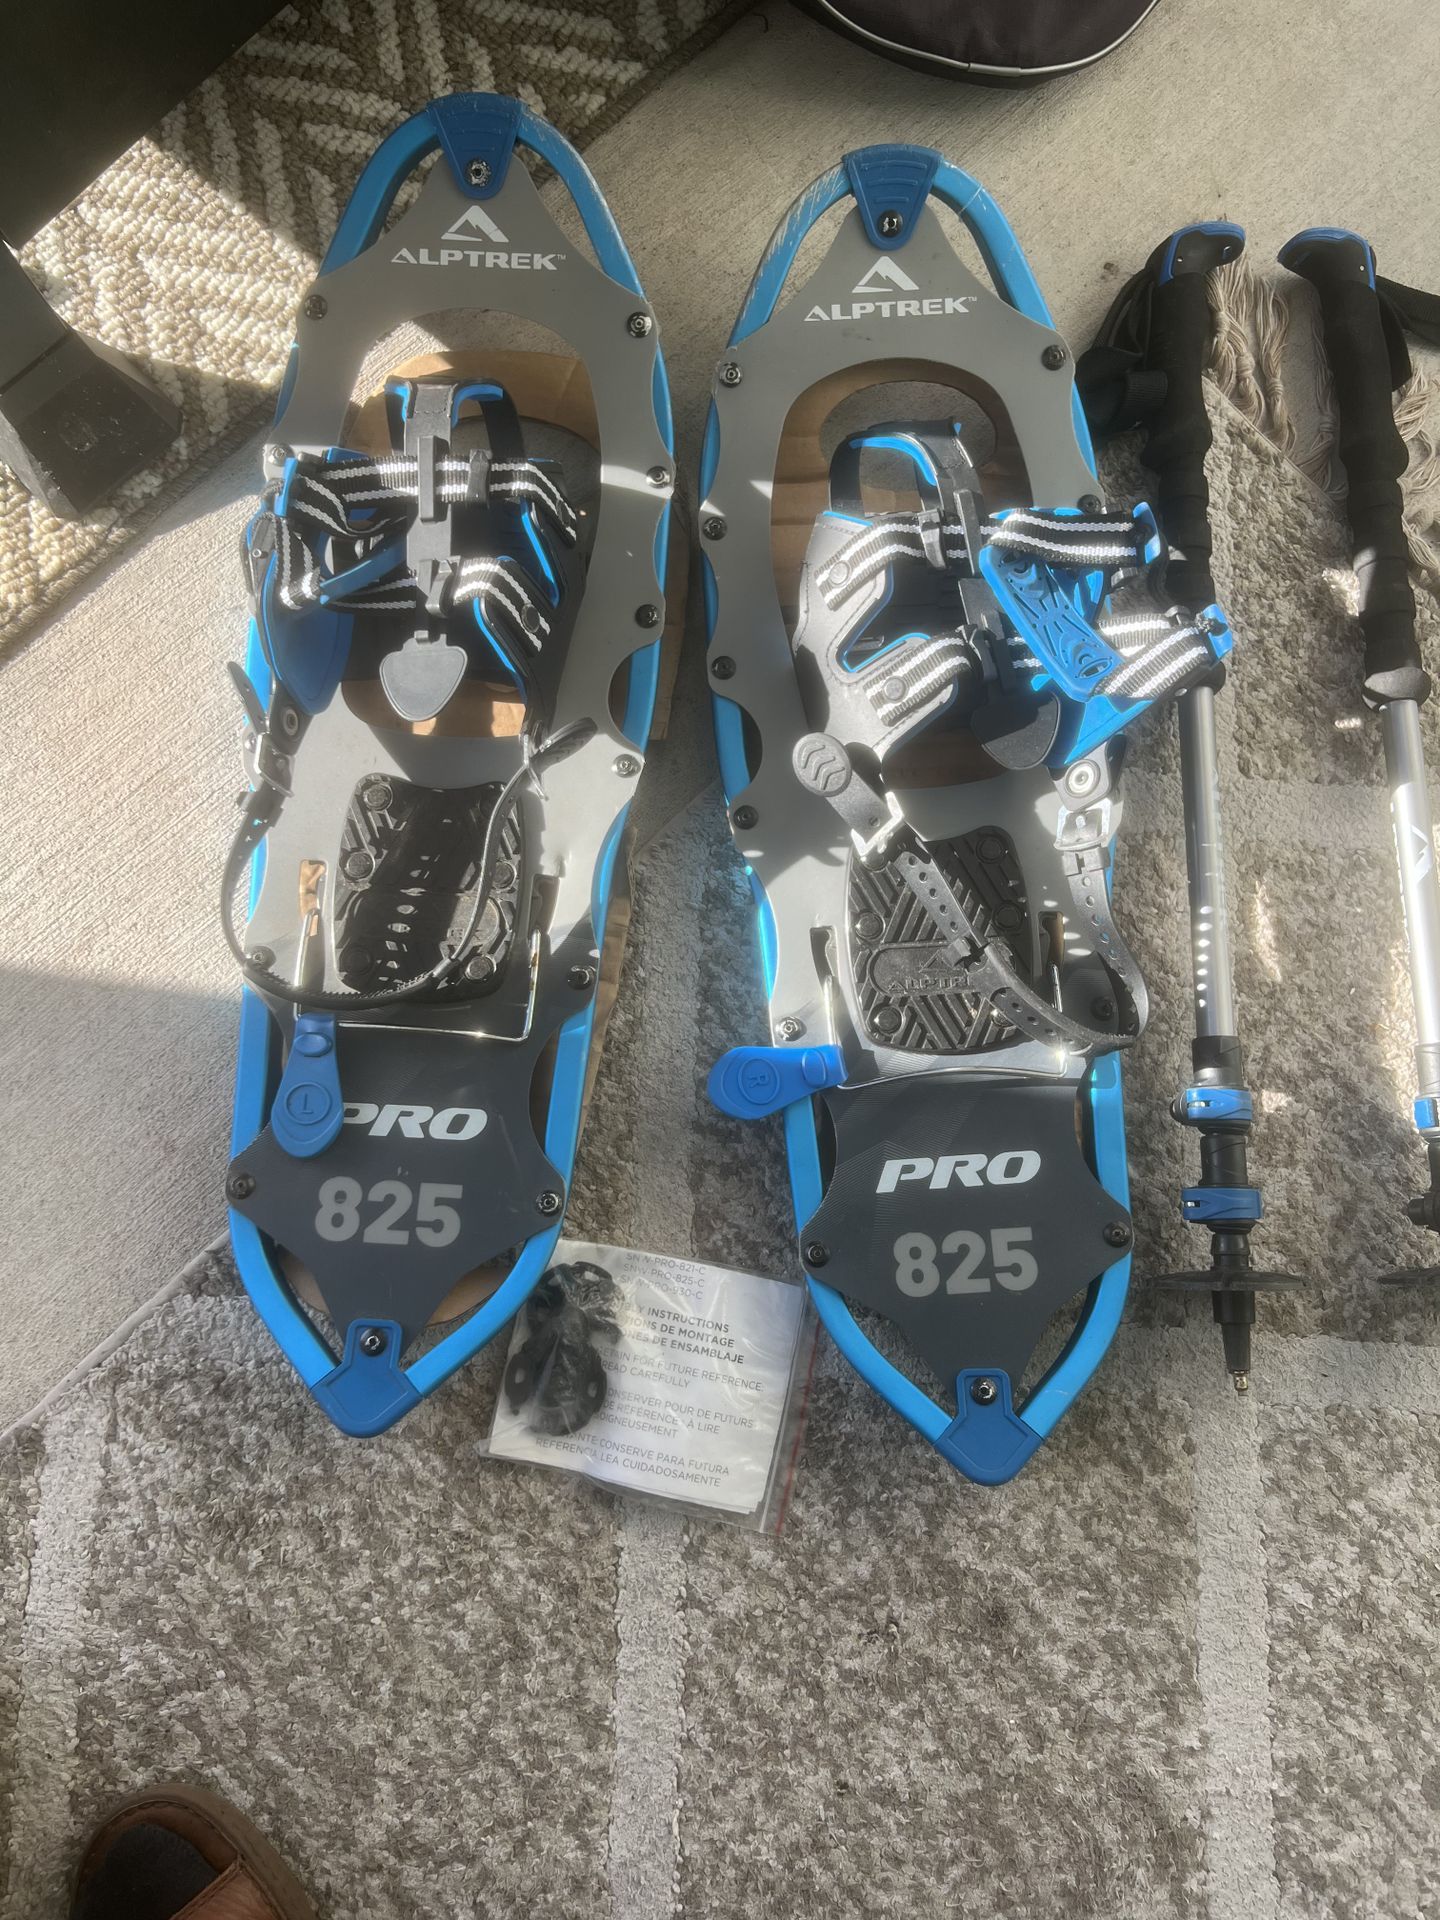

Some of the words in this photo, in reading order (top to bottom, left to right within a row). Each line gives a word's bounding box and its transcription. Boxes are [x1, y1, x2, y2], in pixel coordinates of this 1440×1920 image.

[300, 1092, 314, 1115] L
[875, 1150, 1042, 1194] PRO
[314, 1176, 464, 1248] 825
[893, 1226, 1039, 1298] 825
[647, 1306, 730, 1334] INSTRUCTIONS
[652, 1335, 668, 1347] DE
[671, 1340, 745, 1364] ENSAMBLAJE
[660, 1323, 676, 1335] DE
[678, 1329, 735, 1348] MONTAGE
[600, 1347, 631, 1361] ETAIN
[632, 1354, 656, 1367] FOR
[657, 1360, 700, 1378] FUTURE
[602, 1360, 628, 1374] READ
[630, 1366, 691, 1388] CAREFULLY
[607, 1387, 663, 1409] ONSERVER
[664, 1400, 695, 1417] POUR
[696, 1408, 711, 1420] DE
[714, 1412, 754, 1429] FUTURS
[599, 1411, 678, 1438] OIGNEUSEMENT
[697, 1423, 721, 1435] LIRE
[600, 1438, 654, 1460] CONSERVE
[656, 1452, 686, 1468] PARA
[687, 1459, 731, 1476] FUTURA
[600, 1452, 620, 1466] LEA
[622, 1459, 722, 1488] CUIDADOSAMENTE
